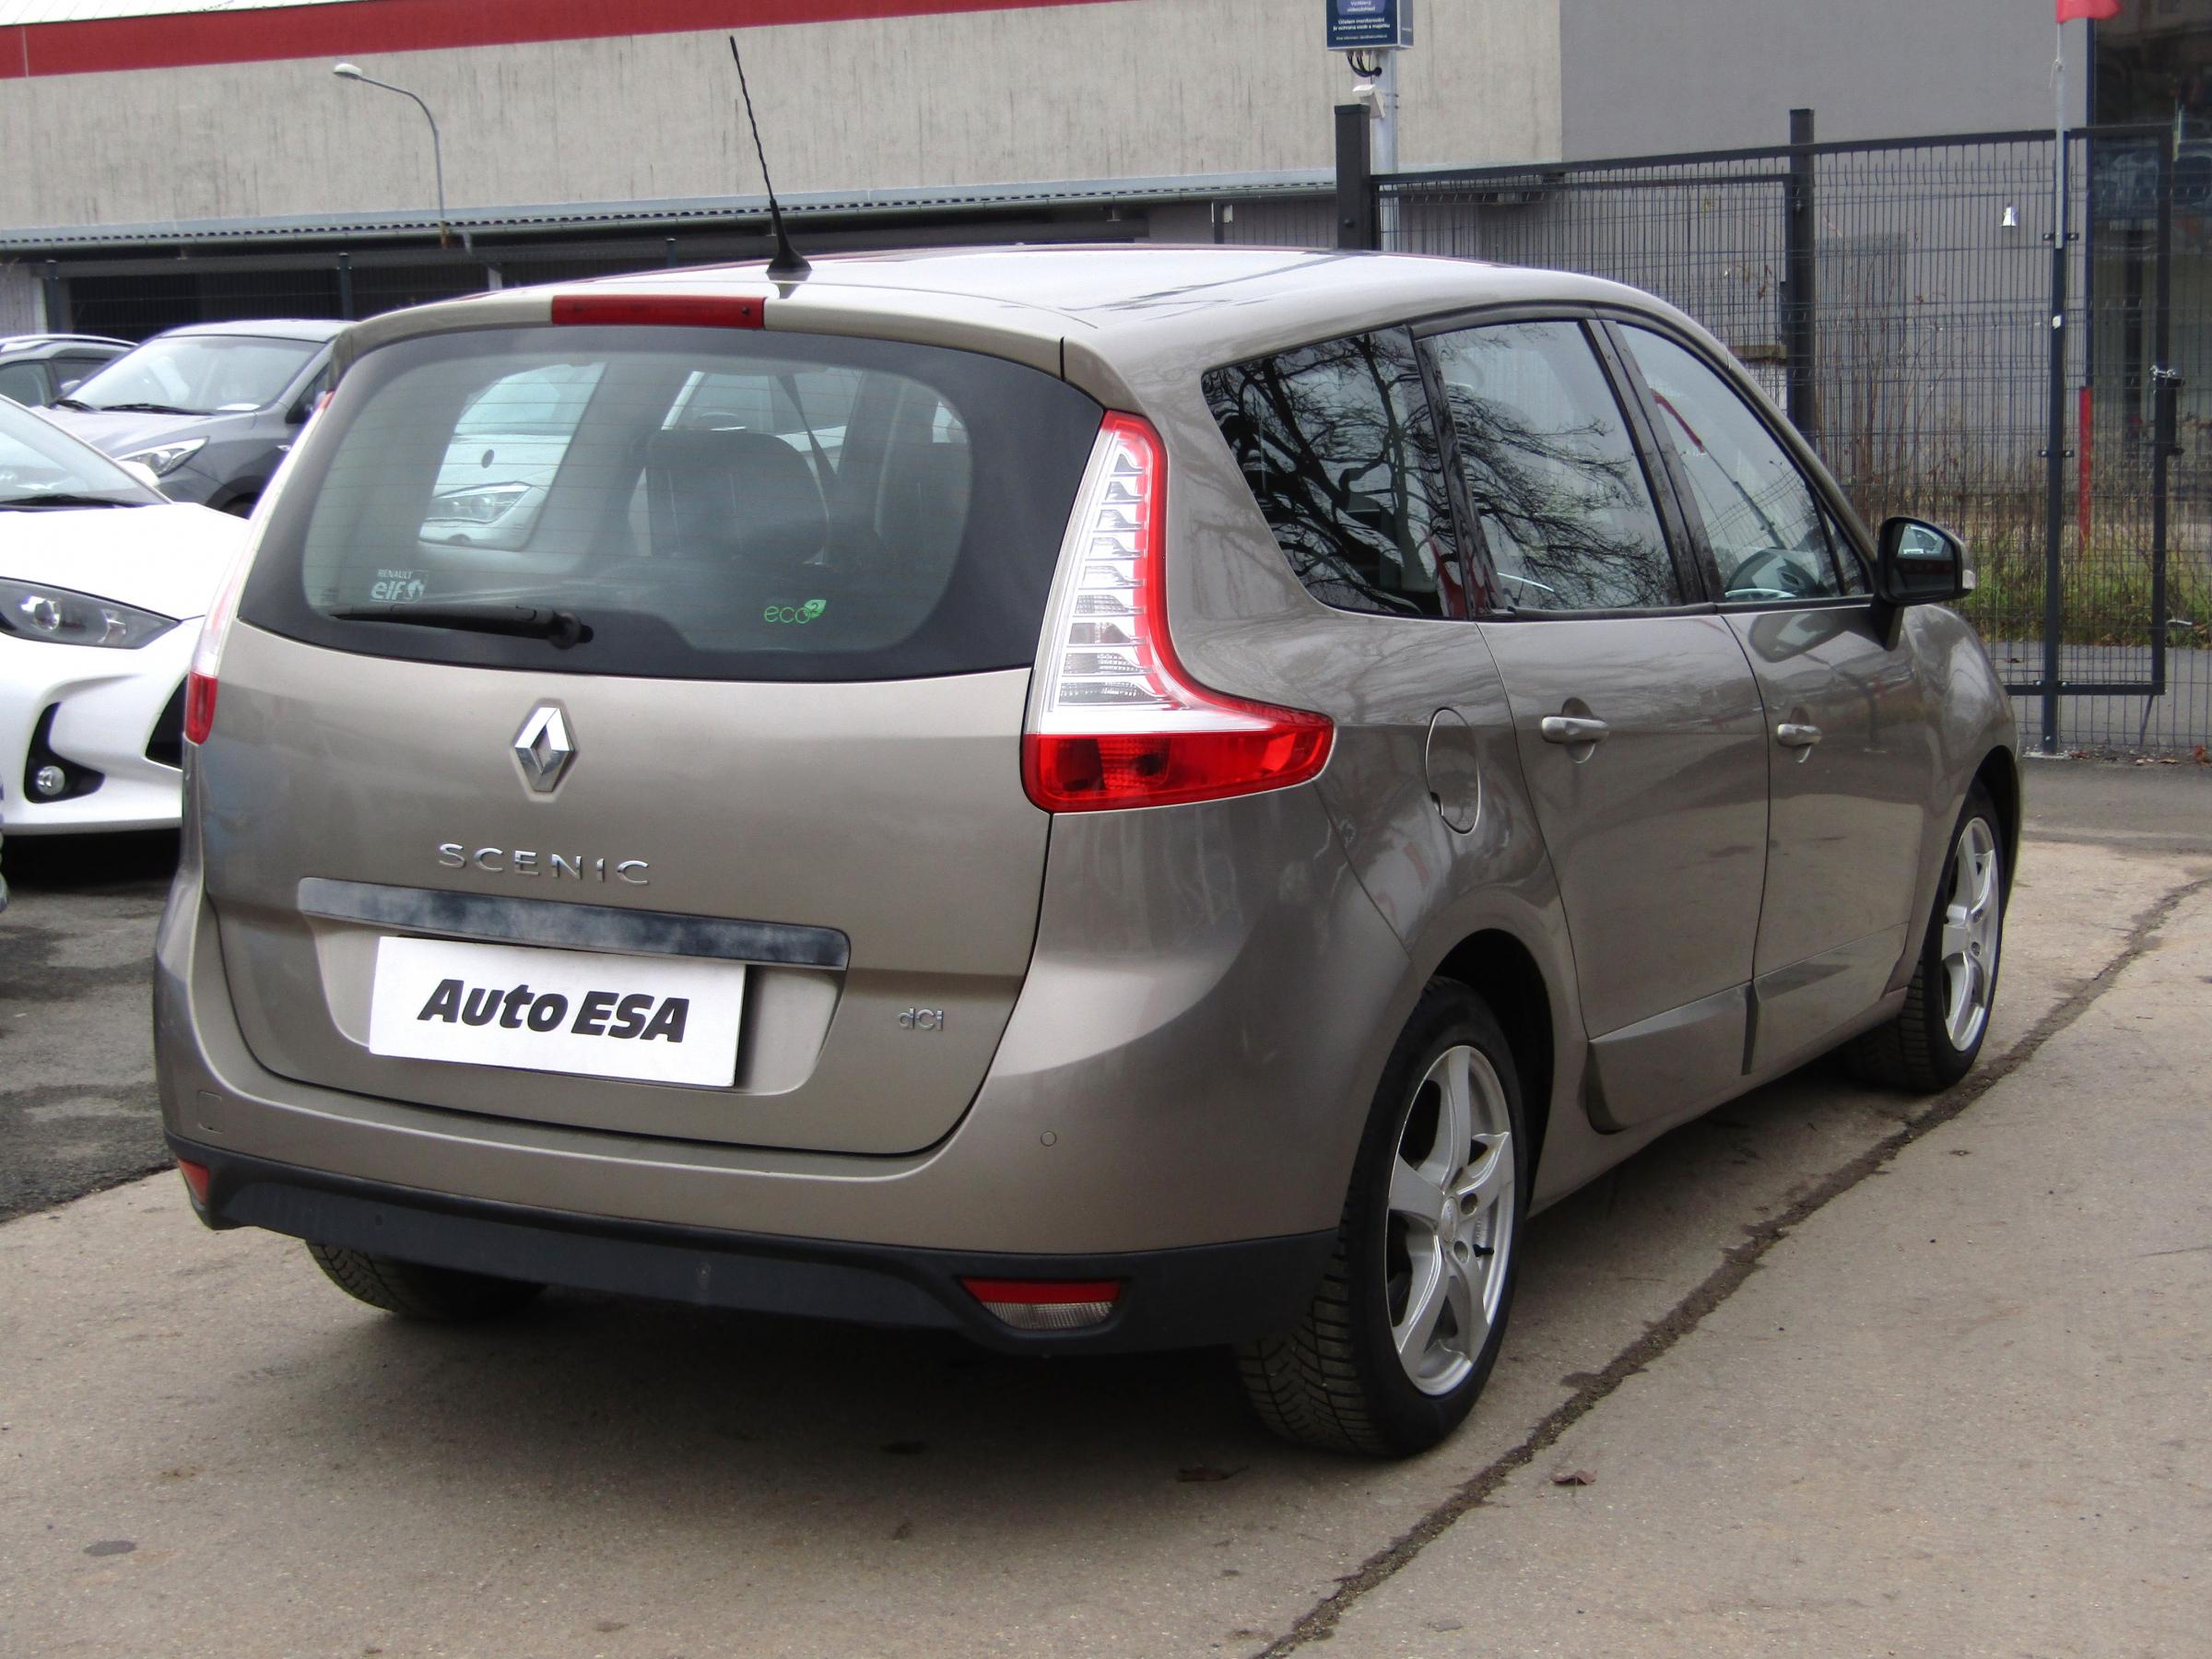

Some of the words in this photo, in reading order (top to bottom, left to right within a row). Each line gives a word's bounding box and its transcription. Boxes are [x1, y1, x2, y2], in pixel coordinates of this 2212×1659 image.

[377, 568, 413, 579] RENAULT
[371, 581, 406, 600] elf
[439, 843, 649, 885] SCENIC
[417, 978, 569, 1032] Auto
[571, 991, 690, 1043] ESA
